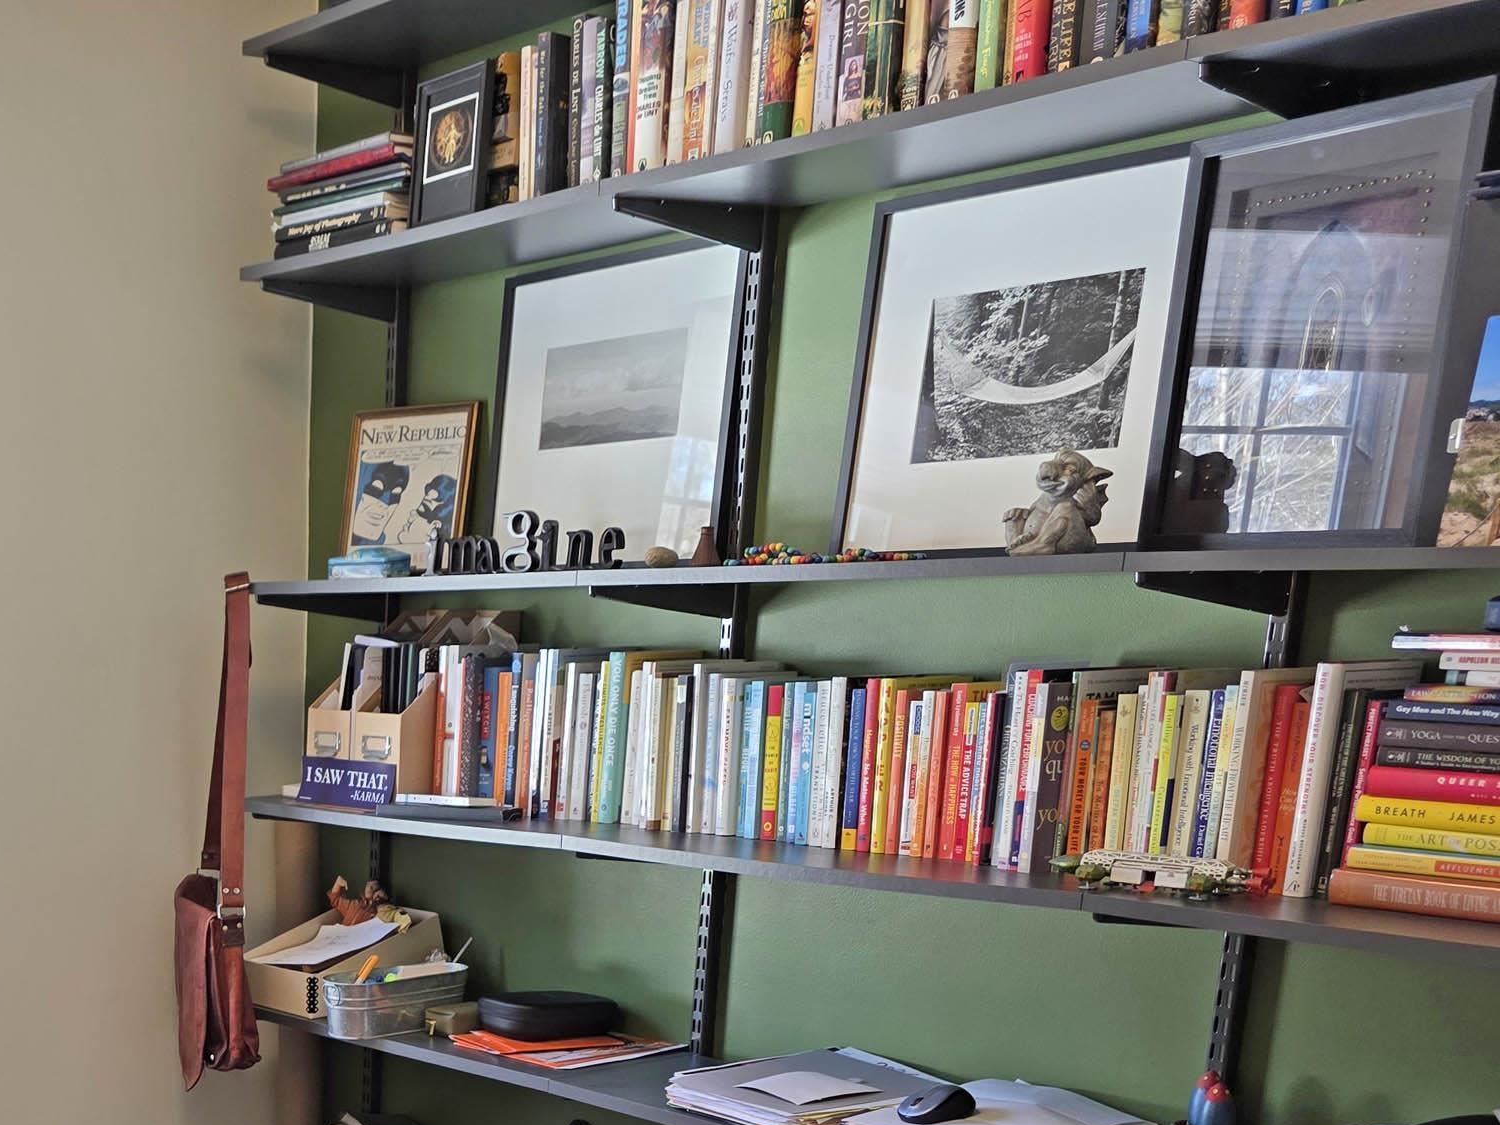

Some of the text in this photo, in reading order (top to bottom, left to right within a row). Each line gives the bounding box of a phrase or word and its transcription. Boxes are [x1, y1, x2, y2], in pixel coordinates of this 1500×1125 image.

[616, 0, 628, 66] TRADER
[842, 3, 856, 56] GIRL
[1058, 16, 1074, 60] LIFE
[595, 28, 606, 79] YARROW
[720, 24, 738, 123] Waifs Strays
[593, 85, 604, 158] CHARLES de LINT
[361, 424, 468, 445] NEW REPUBLIC
[422, 509, 626, 576] imagine
[482, 695, 490, 735] SWITCH
[508, 684, 519, 732] Languishing
[605, 659, 623, 766] YOU ONLY DIE ONCE
[802, 703, 814, 754] mindset
[1012, 706, 1022, 728] Heart
[1312, 696, 1324, 738] DISCOVER
[1366, 708, 1376, 730] PERFECT
[1396, 705, 1411, 714] Gay
[1462, 708, 1480, 716] New
[1482, 709, 1500, 718] Way
[894, 714, 905, 759] POSITIVITY
[1018, 694, 1037, 792] COACHING FOR PERFORMANCE
[1044, 740, 1066, 762] yo
[1229, 726, 1244, 768] WORKING
[1308, 742, 1317, 764] YOUR
[1411, 730, 1440, 740] YOGA
[864, 763, 870, 772] No
[1008, 740, 1018, 774] Coaching
[1418, 752, 1434, 761] THE
[1436, 754, 1472, 764] WISDOM
[1474, 756, 1486, 764] OF
[306, 766, 388, 790] I SAW THAT.
[861, 774, 869, 803] Matter
[946, 746, 961, 825] THE HOW HAPPINESS
[958, 750, 972, 819] THE ADVICE TRAP
[1175, 724, 1199, 846] Working with Emotional Intelligence
[1198, 718, 1222, 845] Emotional Intelligence Daniel
[1256, 720, 1283, 863] THE TRUTH ABOUT LEADERSHIP
[1301, 768, 1314, 815] STRENGTHS
[1356, 768, 1366, 788] Setting
[1437, 776, 1487, 788] QUEER
[1036, 808, 1058, 830] yo
[1070, 758, 1087, 852] YOUR MONEY OR YOUR LIFE
[1374, 806, 1496, 824] BREATH JAMES
[1347, 827, 1356, 844] Goals
[1396, 833, 1413, 841] THE
[1416, 834, 1446, 846] ART
[1440, 865, 1494, 875] AFFLUENCE
[1372, 884, 1489, 912] THE TIBETAN BOOK OF LIVING
